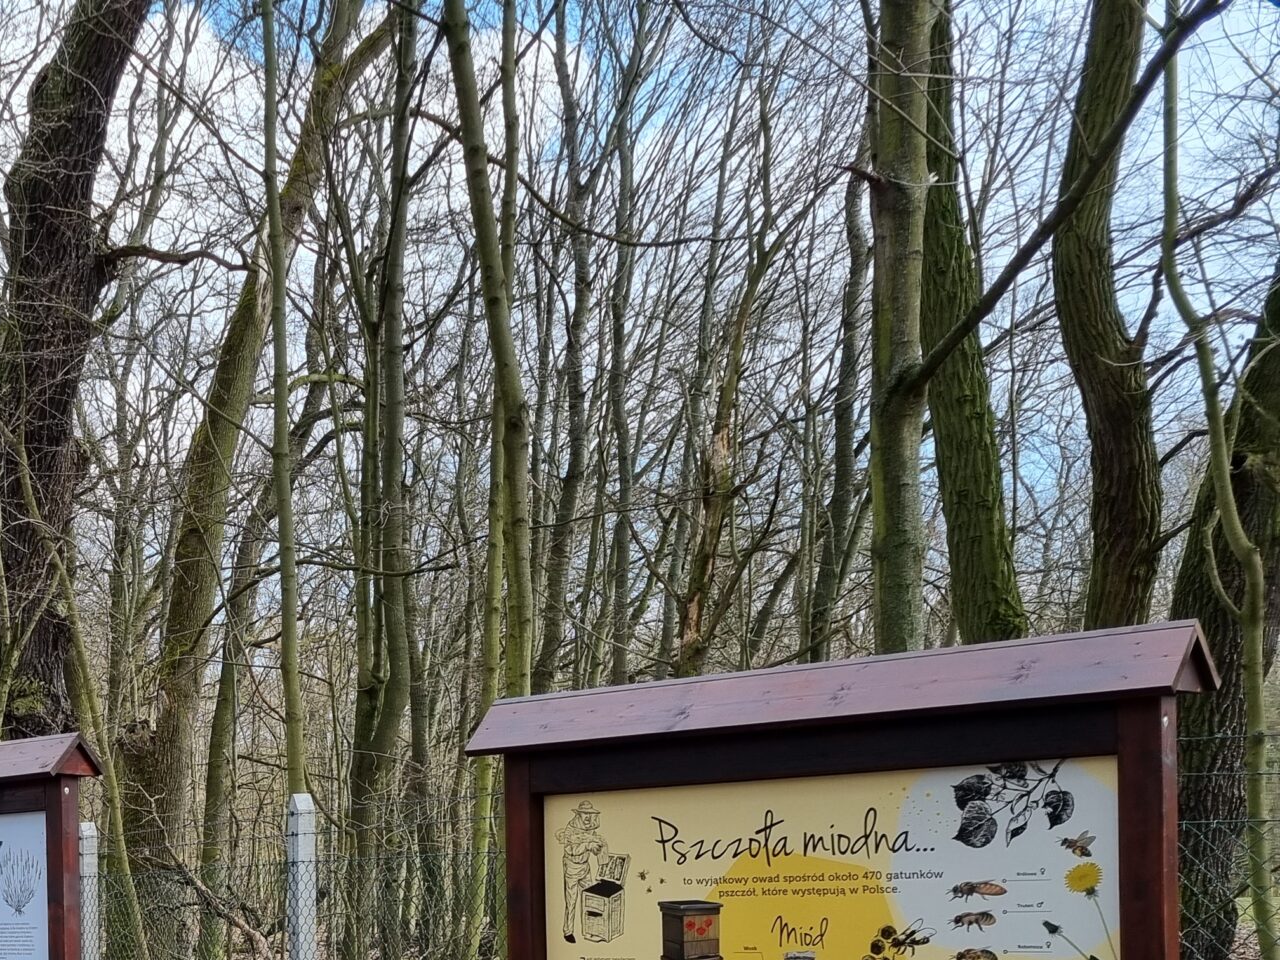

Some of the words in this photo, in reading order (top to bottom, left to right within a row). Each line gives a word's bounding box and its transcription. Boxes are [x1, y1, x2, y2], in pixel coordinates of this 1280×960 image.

[651, 809, 794, 867] Pszczoła
[803, 807, 935, 859] miodna...
[683, 877, 694, 886] to
[695, 876, 750, 887] wyjątkowy
[751, 874, 781, 884] owad
[782, 873, 826, 885] spośród
[827, 871, 859, 882] około
[862, 870, 882, 881] 470
[886, 869, 945, 882] gatunków
[761, 886, 788, 897] które
[790, 885, 846, 898] występują
[849, 886, 859, 895] w
[862, 883, 902, 895] Polsce.
[770, 915, 829, 950] Miód
